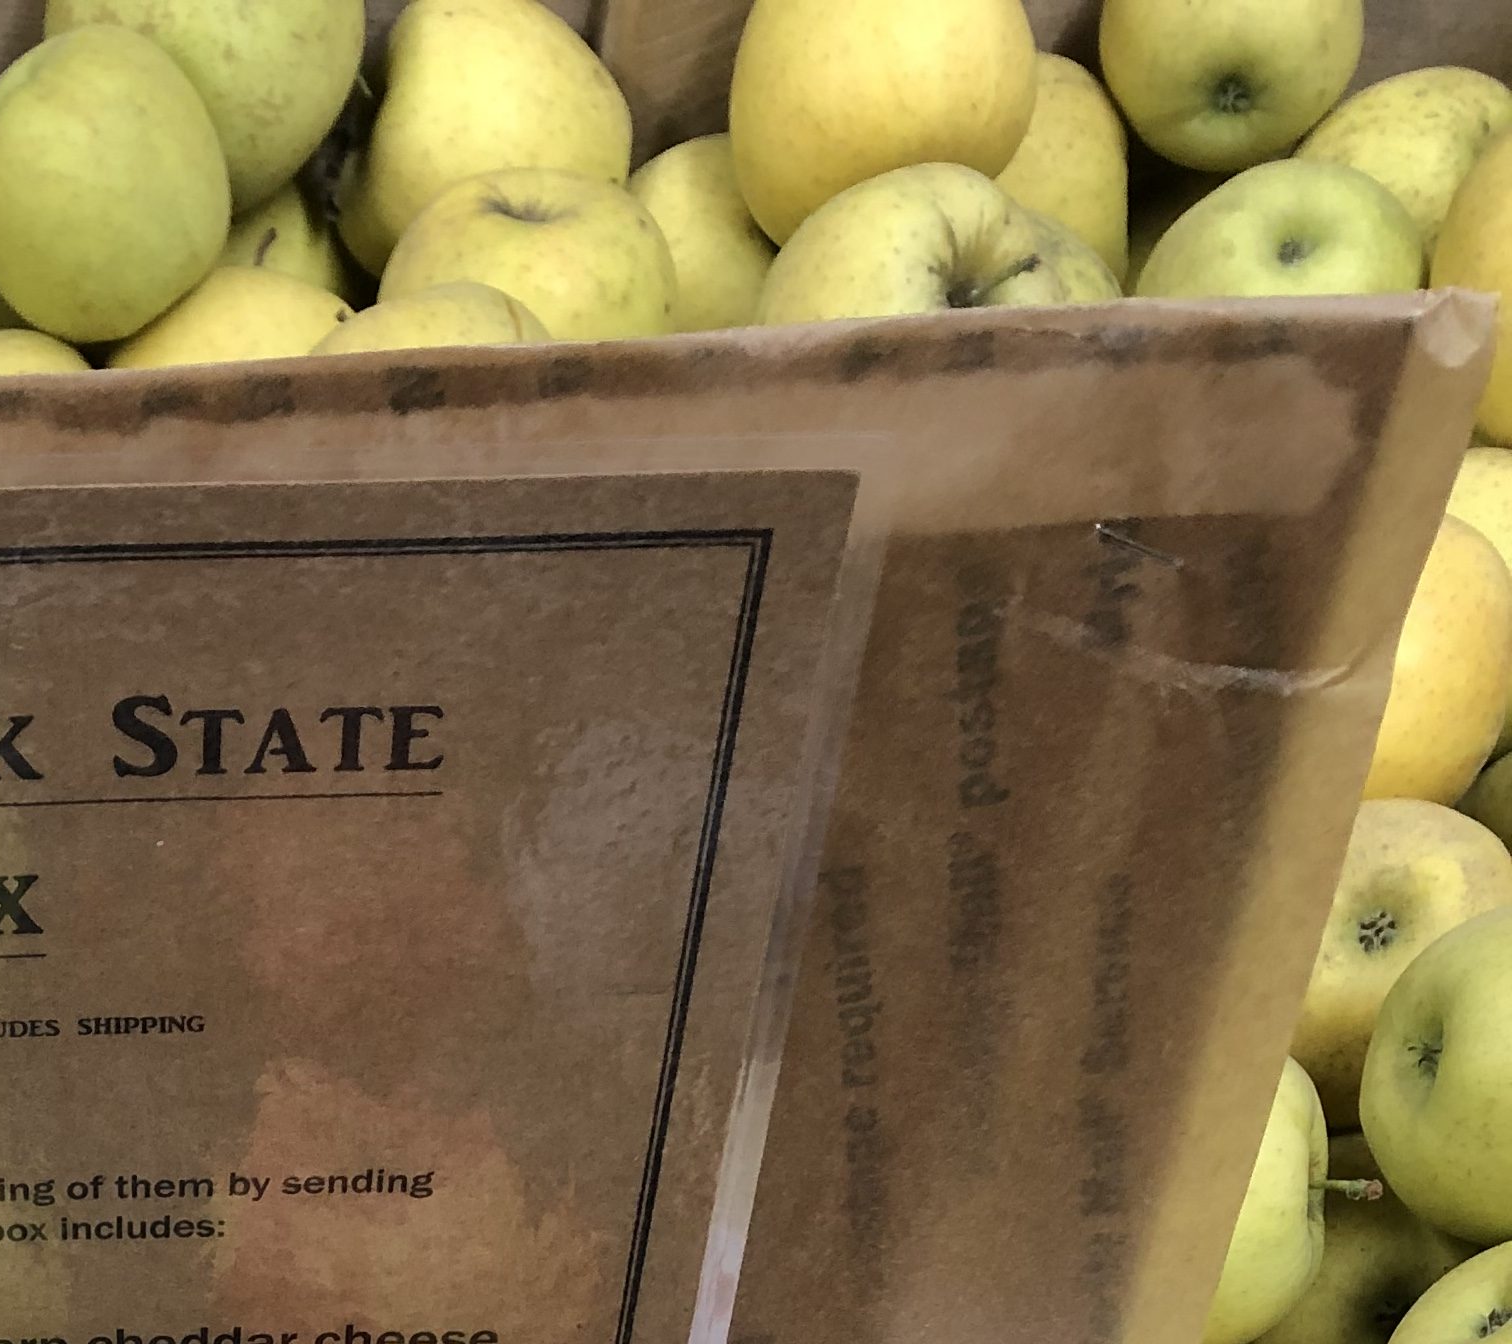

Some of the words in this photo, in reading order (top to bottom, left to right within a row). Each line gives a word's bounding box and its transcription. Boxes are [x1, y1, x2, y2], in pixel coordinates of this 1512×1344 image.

[77, 1012, 205, 1037] SHIPPING
[67, 1176, 105, 1199] of
[115, 1175, 215, 1199] them
[229, 1172, 271, 1200] by
[282, 1169, 435, 1199] sending
[60, 1214, 227, 1242] includes:
